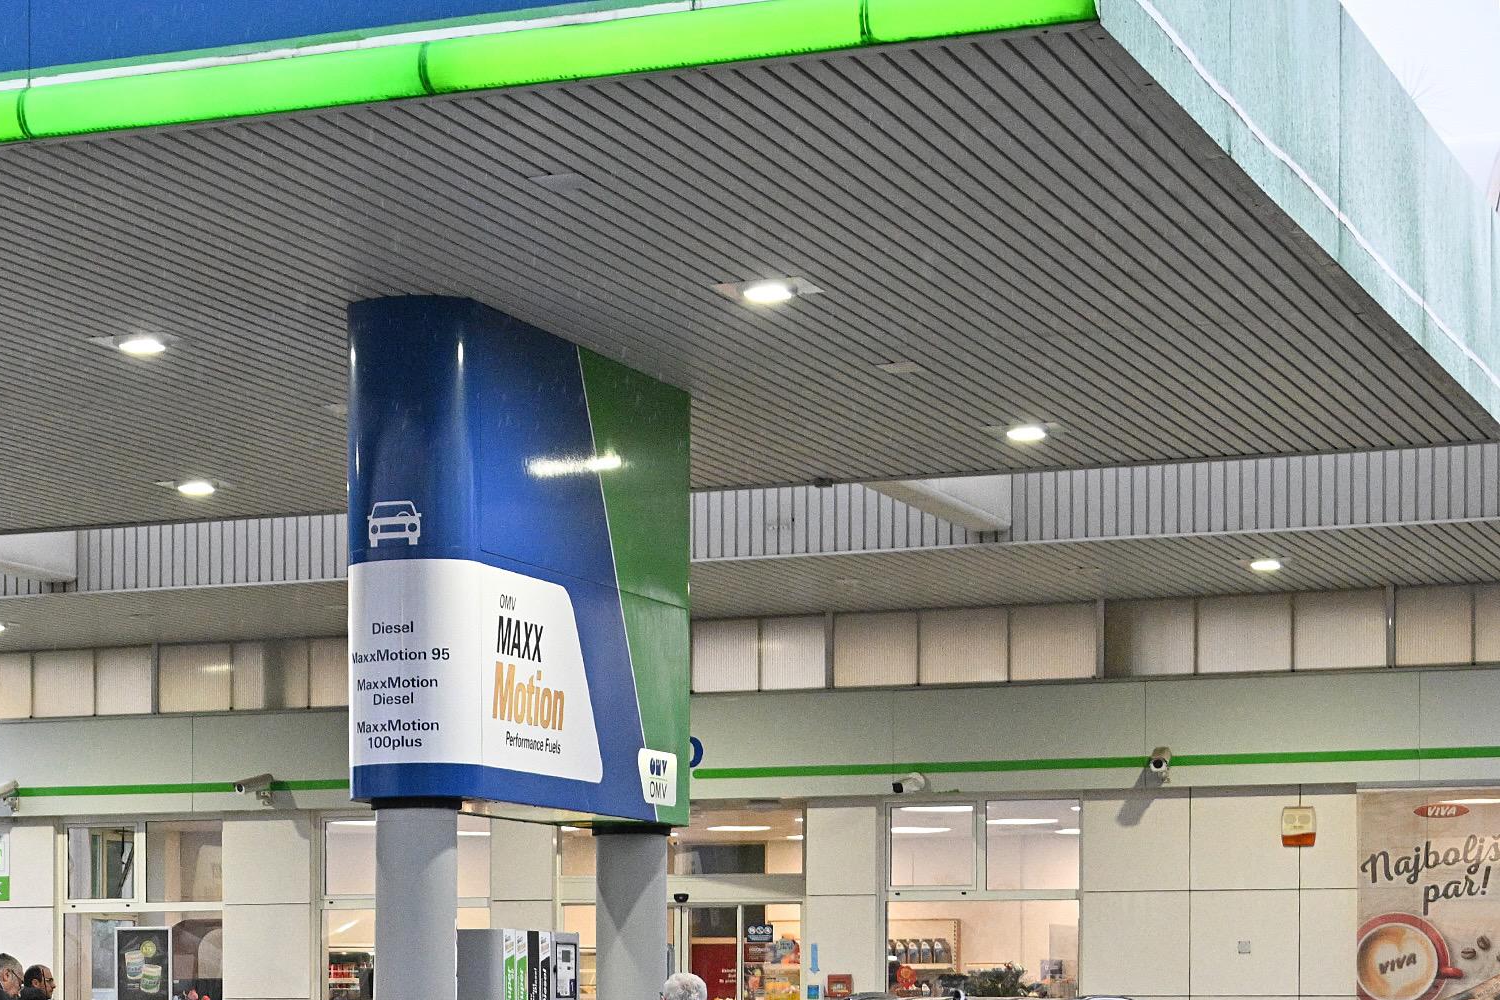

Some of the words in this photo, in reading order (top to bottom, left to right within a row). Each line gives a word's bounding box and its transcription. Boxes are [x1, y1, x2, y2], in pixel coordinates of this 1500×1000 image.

[499, 593, 517, 611] OMV
[372, 620, 414, 635] Diesel
[496, 615, 544, 663] MAXX
[431, 647, 450, 661] 95
[357, 675, 438, 692] MaxxMotion
[373, 692, 414, 706] Diesel
[492, 660, 565, 731] Motion
[356, 718, 440, 734] MaxxMotion
[368, 735, 423, 750] 100plus
[506, 730, 544, 752] Performance
[545, 737, 561, 754] Fuels
[649, 781, 668, 799] OMV
[1427, 805, 1457, 817] VIVA
[1422, 865, 1492, 916] par!
[1379, 953, 1417, 975] VIVA
